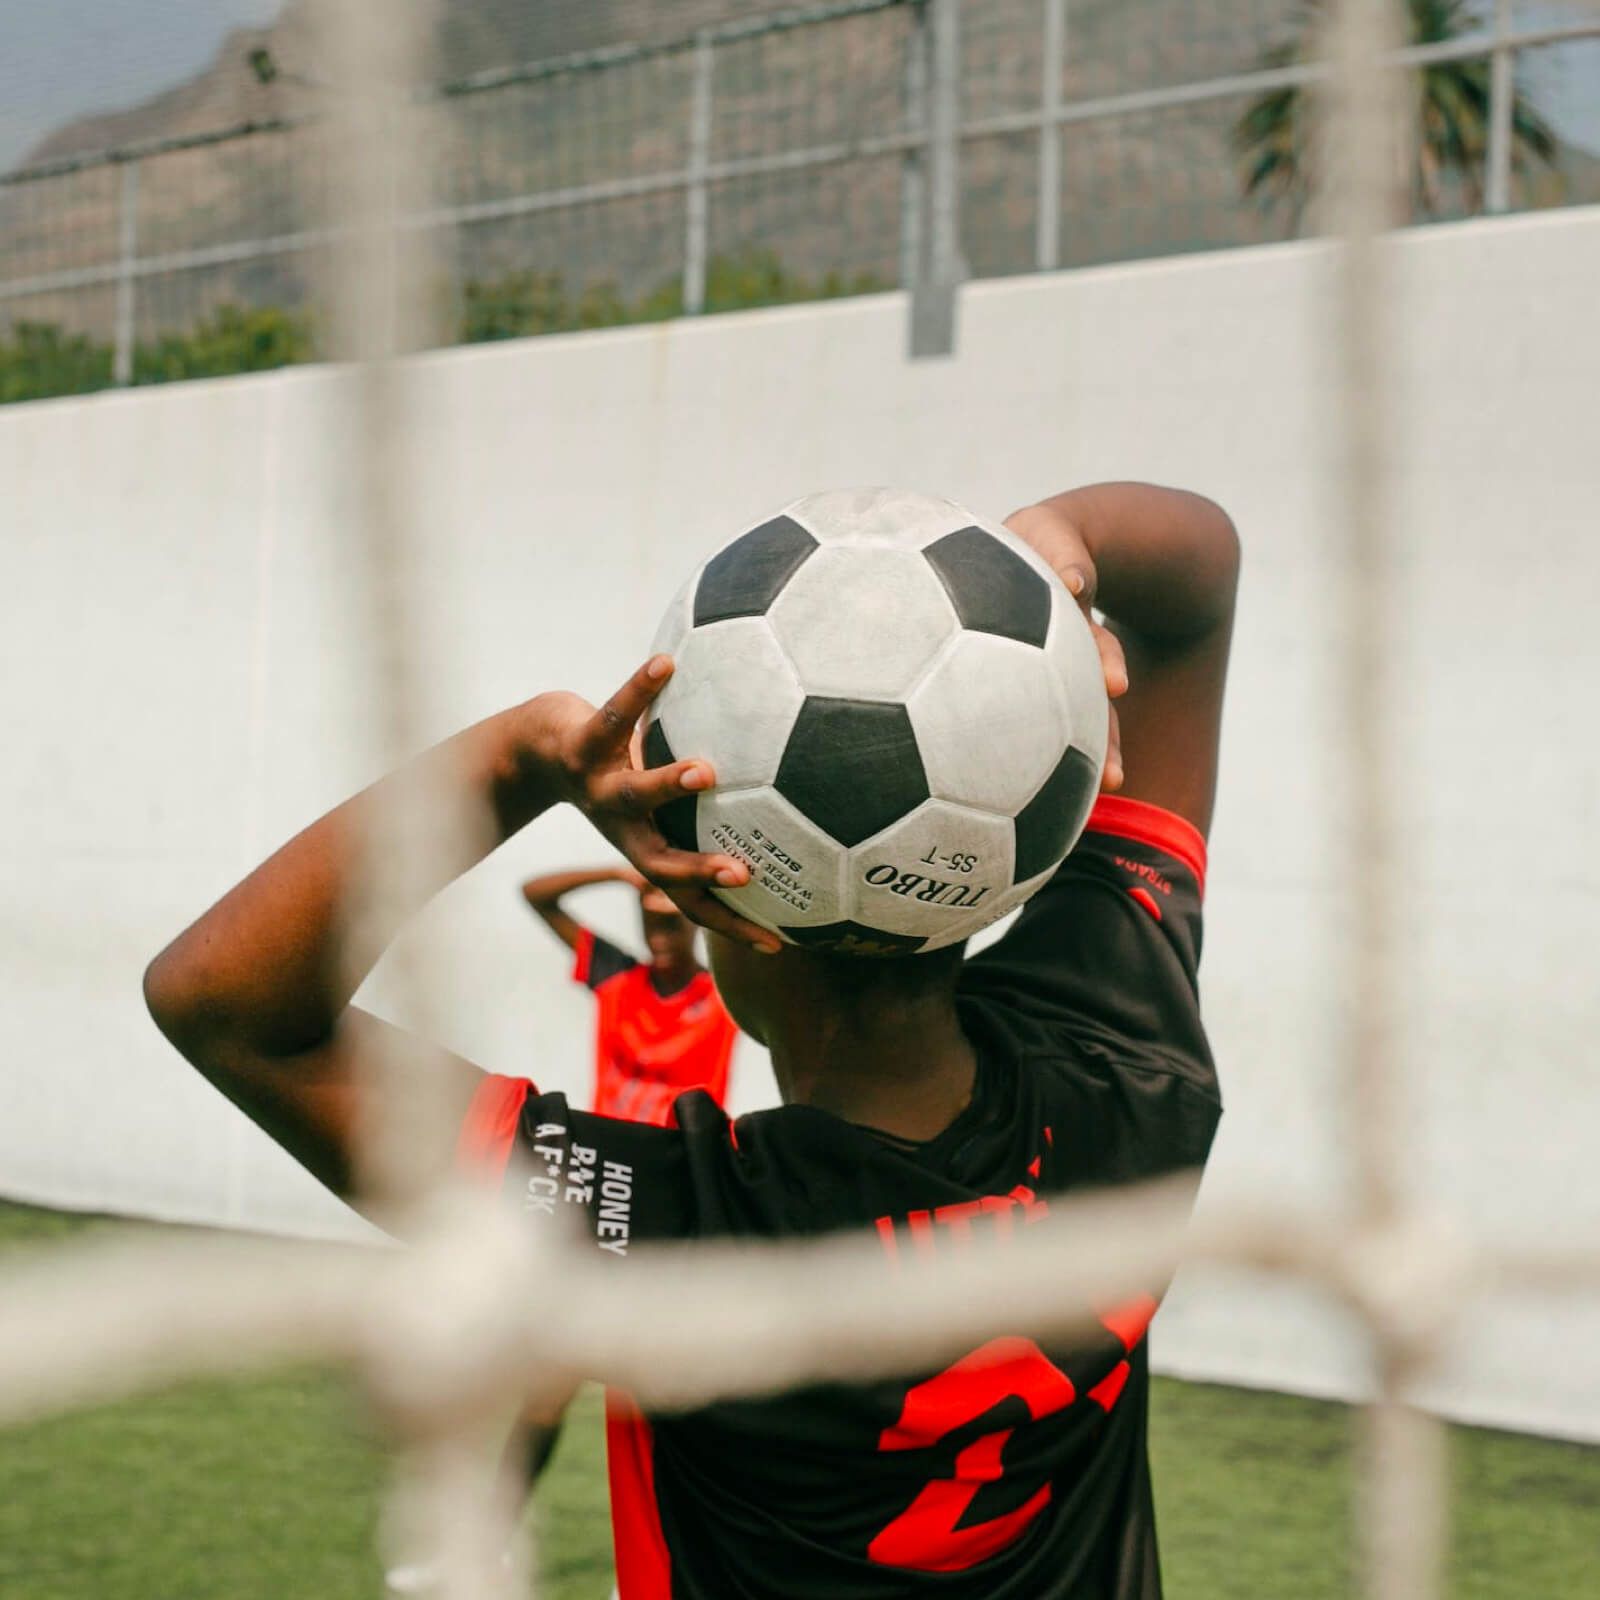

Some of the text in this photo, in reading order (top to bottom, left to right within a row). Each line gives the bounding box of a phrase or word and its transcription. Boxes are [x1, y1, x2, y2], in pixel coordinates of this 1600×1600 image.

[763, 840, 803, 873] SIZE
[920, 846, 978, 873] S5-T
[760, 876, 809, 911] NYLON
[765, 863, 813, 900] WATER
[865, 864, 991, 908] TURBO
[535, 1123, 567, 1138] A
[597, 1160, 633, 1257] HONEY
